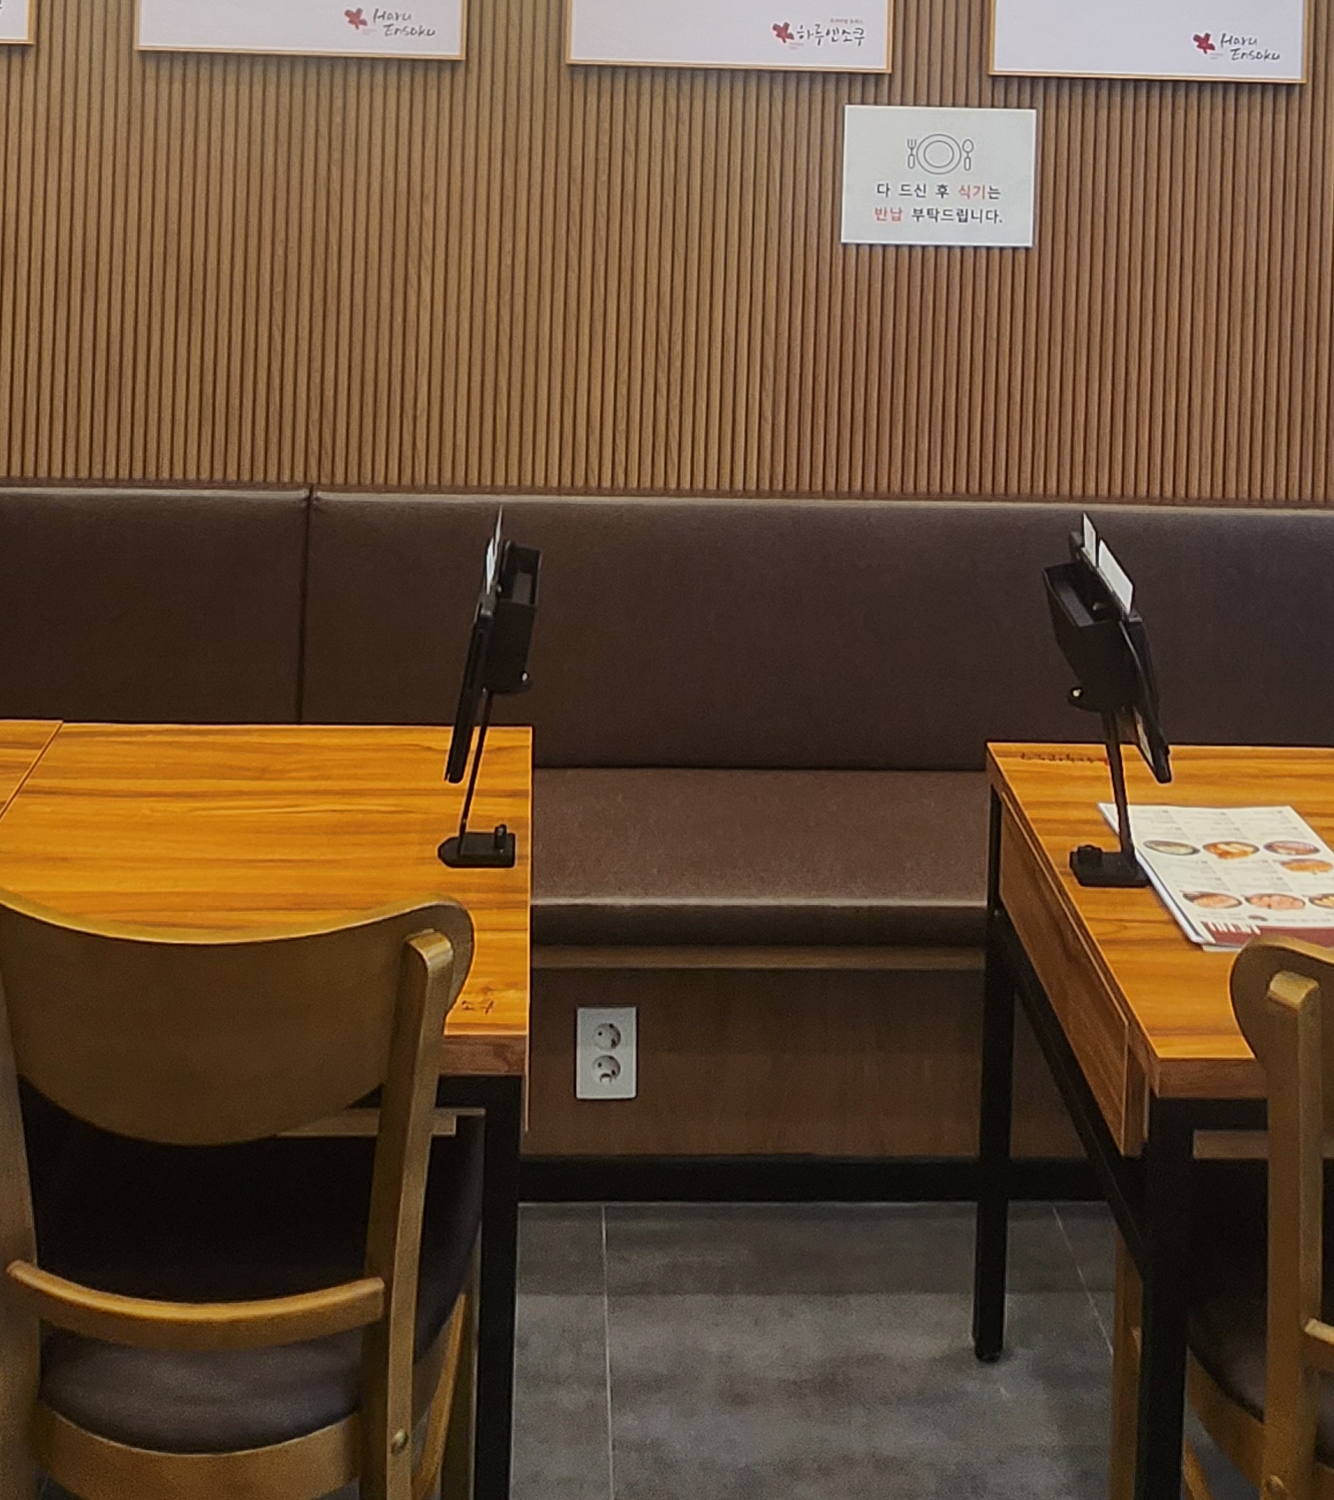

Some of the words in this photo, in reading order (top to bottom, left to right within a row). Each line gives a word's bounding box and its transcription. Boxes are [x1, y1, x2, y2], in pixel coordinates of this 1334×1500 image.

[373, 8, 412, 23] Haru
[383, 23, 436, 37] Ensoku
[1220, 33, 1258, 48] Haru
[1230, 48, 1281, 61] Ensoku
[876, 183, 891, 197] 다
[898, 184, 926, 198] 드신
[935, 184, 949, 198] 후
[958, 184, 1001, 200] 식기는
[874, 207, 903, 222] 반납
[912, 207, 1003, 224] 부탁드립니다.
